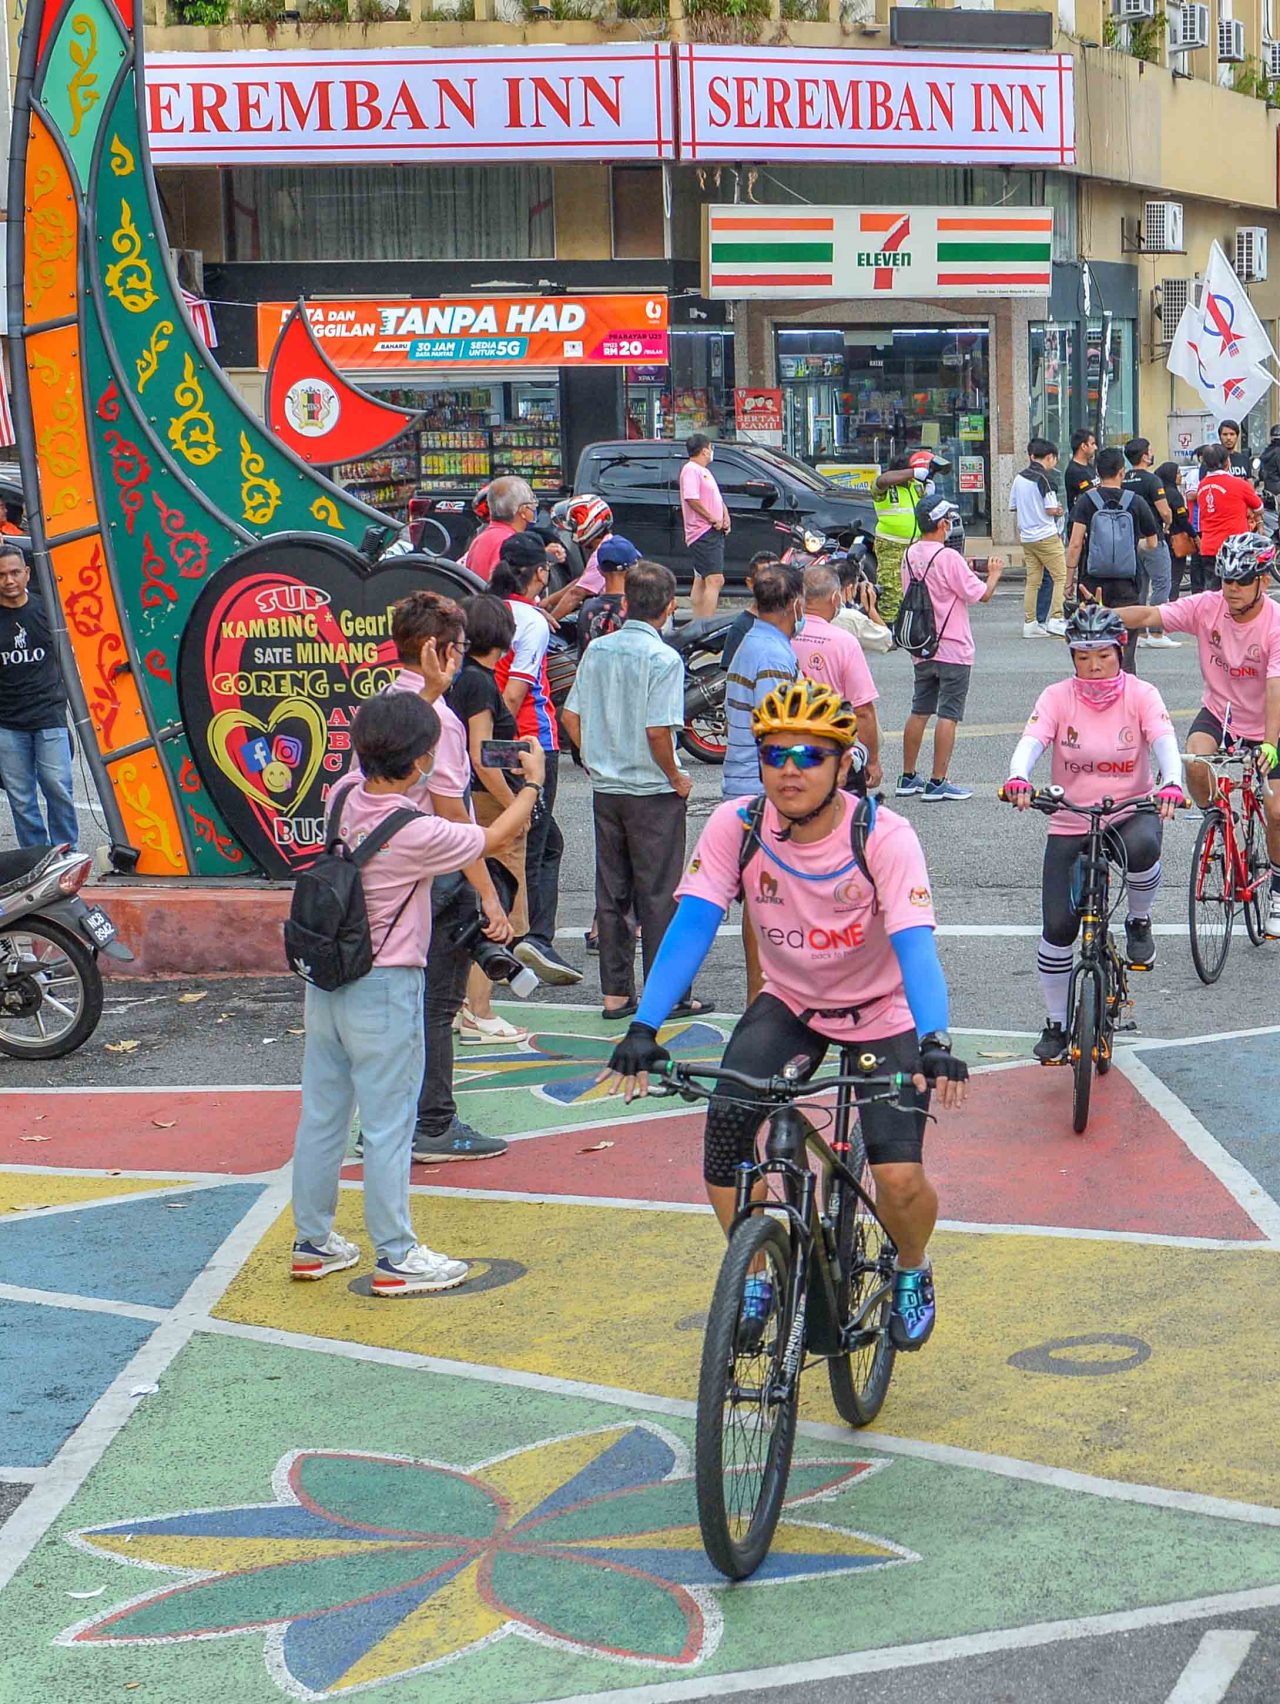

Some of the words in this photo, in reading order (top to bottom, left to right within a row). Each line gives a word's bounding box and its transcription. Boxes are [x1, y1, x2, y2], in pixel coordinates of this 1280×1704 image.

[147, 77, 478, 134] EREMBAN
[504, 75, 625, 129] INN
[707, 75, 956, 132] SEREMBAN
[972, 83, 1047, 133] INN
[860, 213, 910, 290] 7
[281, 308, 325, 323] DTA
[328, 310, 356, 321] DAN
[377, 306, 499, 335] TANPA
[506, 304, 586, 333] HAD
[416, 342, 431, 351] 30
[432, 342, 456, 351] JAM
[469, 349, 495, 357] UNTUK
[471, 341, 496, 350] SEDIA
[496, 341, 521, 356] 5G
[619, 341, 642, 356] 20
[255, 585, 332, 612] SUP
[222, 613, 318, 638] KAMBING
[0, 647, 46, 665] POLO
[254, 647, 293, 664] SATE
[297, 642, 378, 664] MINANG
[212, 669, 330, 698] GORENG
